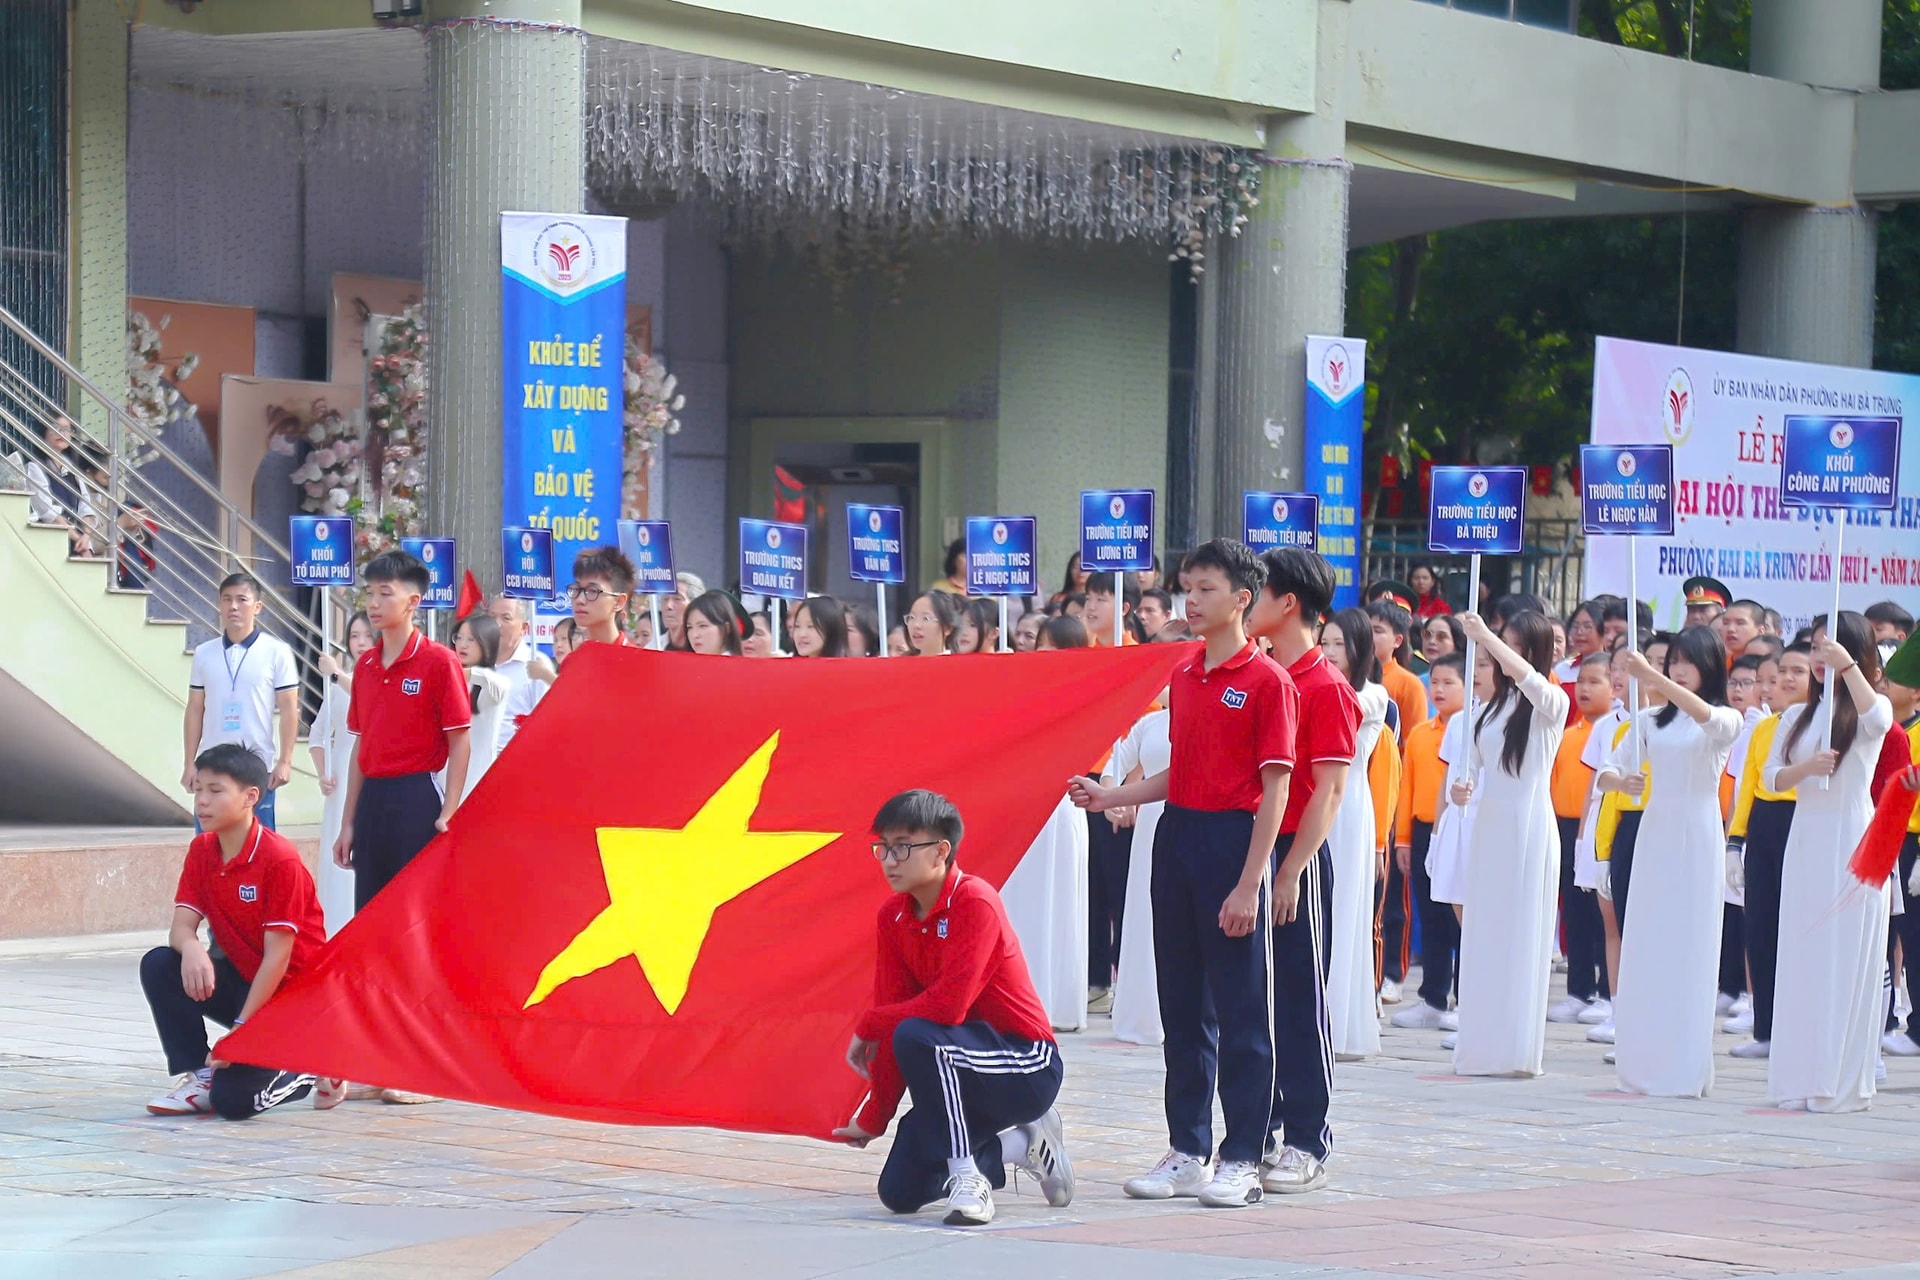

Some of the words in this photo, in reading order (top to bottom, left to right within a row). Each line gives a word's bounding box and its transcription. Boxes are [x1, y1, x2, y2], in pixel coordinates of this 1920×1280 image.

[529, 334, 574, 366] KHỎE
[578, 334, 602, 367] ĐỂ
[523, 380, 554, 409] XÂY
[560, 384, 608, 416] DỰNG
[1729, 379, 1748, 398] BAN
[1750, 379, 1776, 401] NHÂN
[1779, 381, 1798, 403] DÂN
[1841, 390, 1857, 410] HAI
[1858, 386, 1870, 412] BÀ
[552, 424, 576, 453] VÀ
[1737, 414, 1765, 463] LỄ
[1826, 450, 1854, 472] KHỐI
[534, 464, 568, 496] BẢO
[573, 468, 594, 503] VỆ
[1588, 481, 1624, 500] TRƯỜNG
[1626, 478, 1646, 500] TIỂU
[1648, 484, 1667, 504] HỌC
[1787, 471, 1820, 493] CÔNG
[1822, 476, 1839, 493] AN
[1842, 472, 1890, 495] PHƯỜNG
[1673, 479, 1699, 523] ẠI
[1705, 474, 1744, 526] HỘI
[1437, 503, 1474, 520] TRƯỜNG
[1476, 501, 1496, 520] TIỂU
[1498, 506, 1517, 523] HỌC
[1598, 504, 1609, 523] LÊ
[1611, 507, 1637, 526] NGỌC
[1638, 504, 1658, 523] HÂN
[552, 508, 599, 542] QUỐC
[1085, 523, 1115, 540] TRƯỜNG
[1116, 520, 1132, 540] TIỂU
[1133, 525, 1149, 543] HỌC
[1456, 523, 1470, 539] BÀ
[1472, 523, 1498, 542] TRIỆU
[1248, 526, 1278, 544] TRƯỜNG
[1279, 525, 1296, 545] TIỂU
[1297, 531, 1313, 548] HỌC
[311, 545, 333, 561] KHỐI
[744, 550, 779, 568] TRƯỜNG
[780, 555, 803, 571] THCS
[972, 550, 1006, 567] TRƯỜNG
[1008, 553, 1031, 567] THCS
[1122, 543, 1137, 560] YÊN
[1718, 548, 1740, 577] HAI
[1743, 541, 1761, 579] BÀ
[295, 561, 307, 578] TỔ
[309, 563, 329, 578] DÂN
[331, 561, 350, 579] PHỐ
[521, 554, 534, 573] HỘI
[506, 575, 521, 588] CCB
[522, 573, 551, 590] PHƯỜNG
[752, 570, 777, 588] ĐOÀN
[778, 572, 795, 590] KẾT
[973, 568, 984, 585] LÊ
[985, 571, 1009, 588] NGỌC
[436, 584, 453, 601] PHỐ
[1225, 692, 1243, 705] TNT
